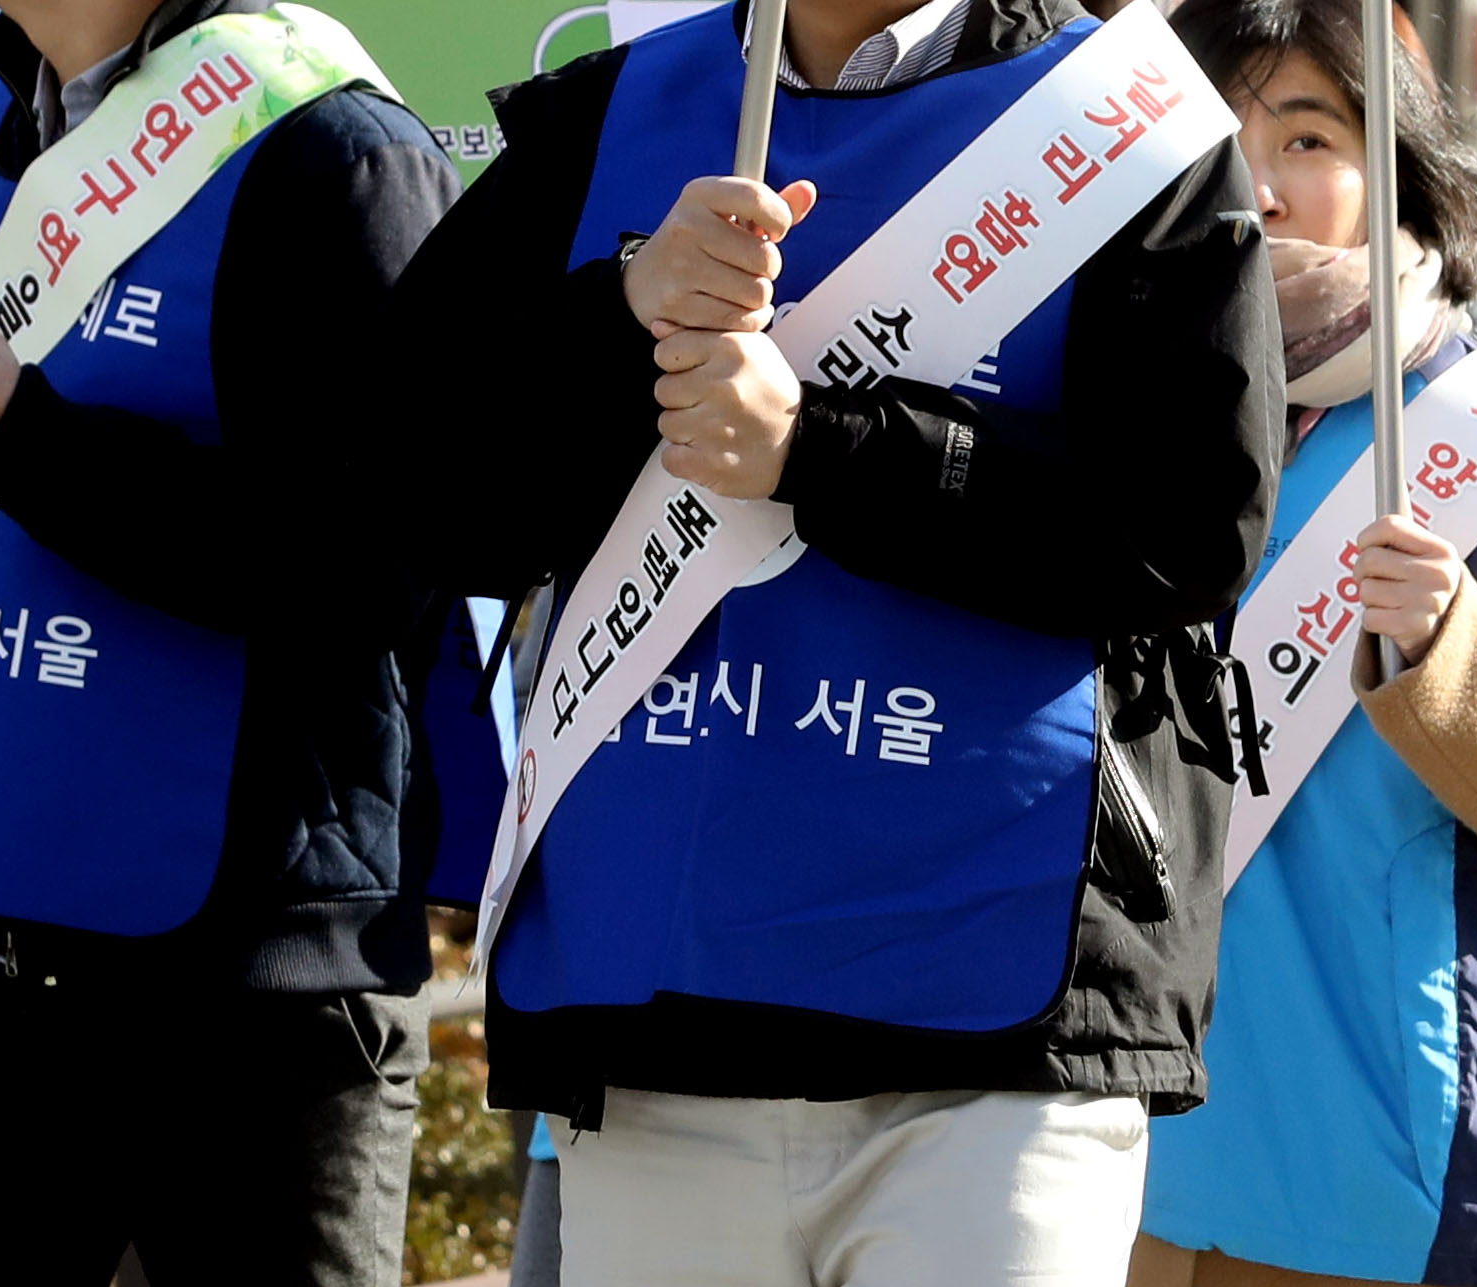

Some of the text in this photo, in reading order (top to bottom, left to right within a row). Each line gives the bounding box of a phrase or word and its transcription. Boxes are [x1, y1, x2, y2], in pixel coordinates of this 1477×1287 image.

[1040, 62, 1185, 206] 길거리
[931, 190, 1042, 306] 흡연
[550, 487, 722, 741] 폭력입니다
[794, 676, 945, 769] 서울
